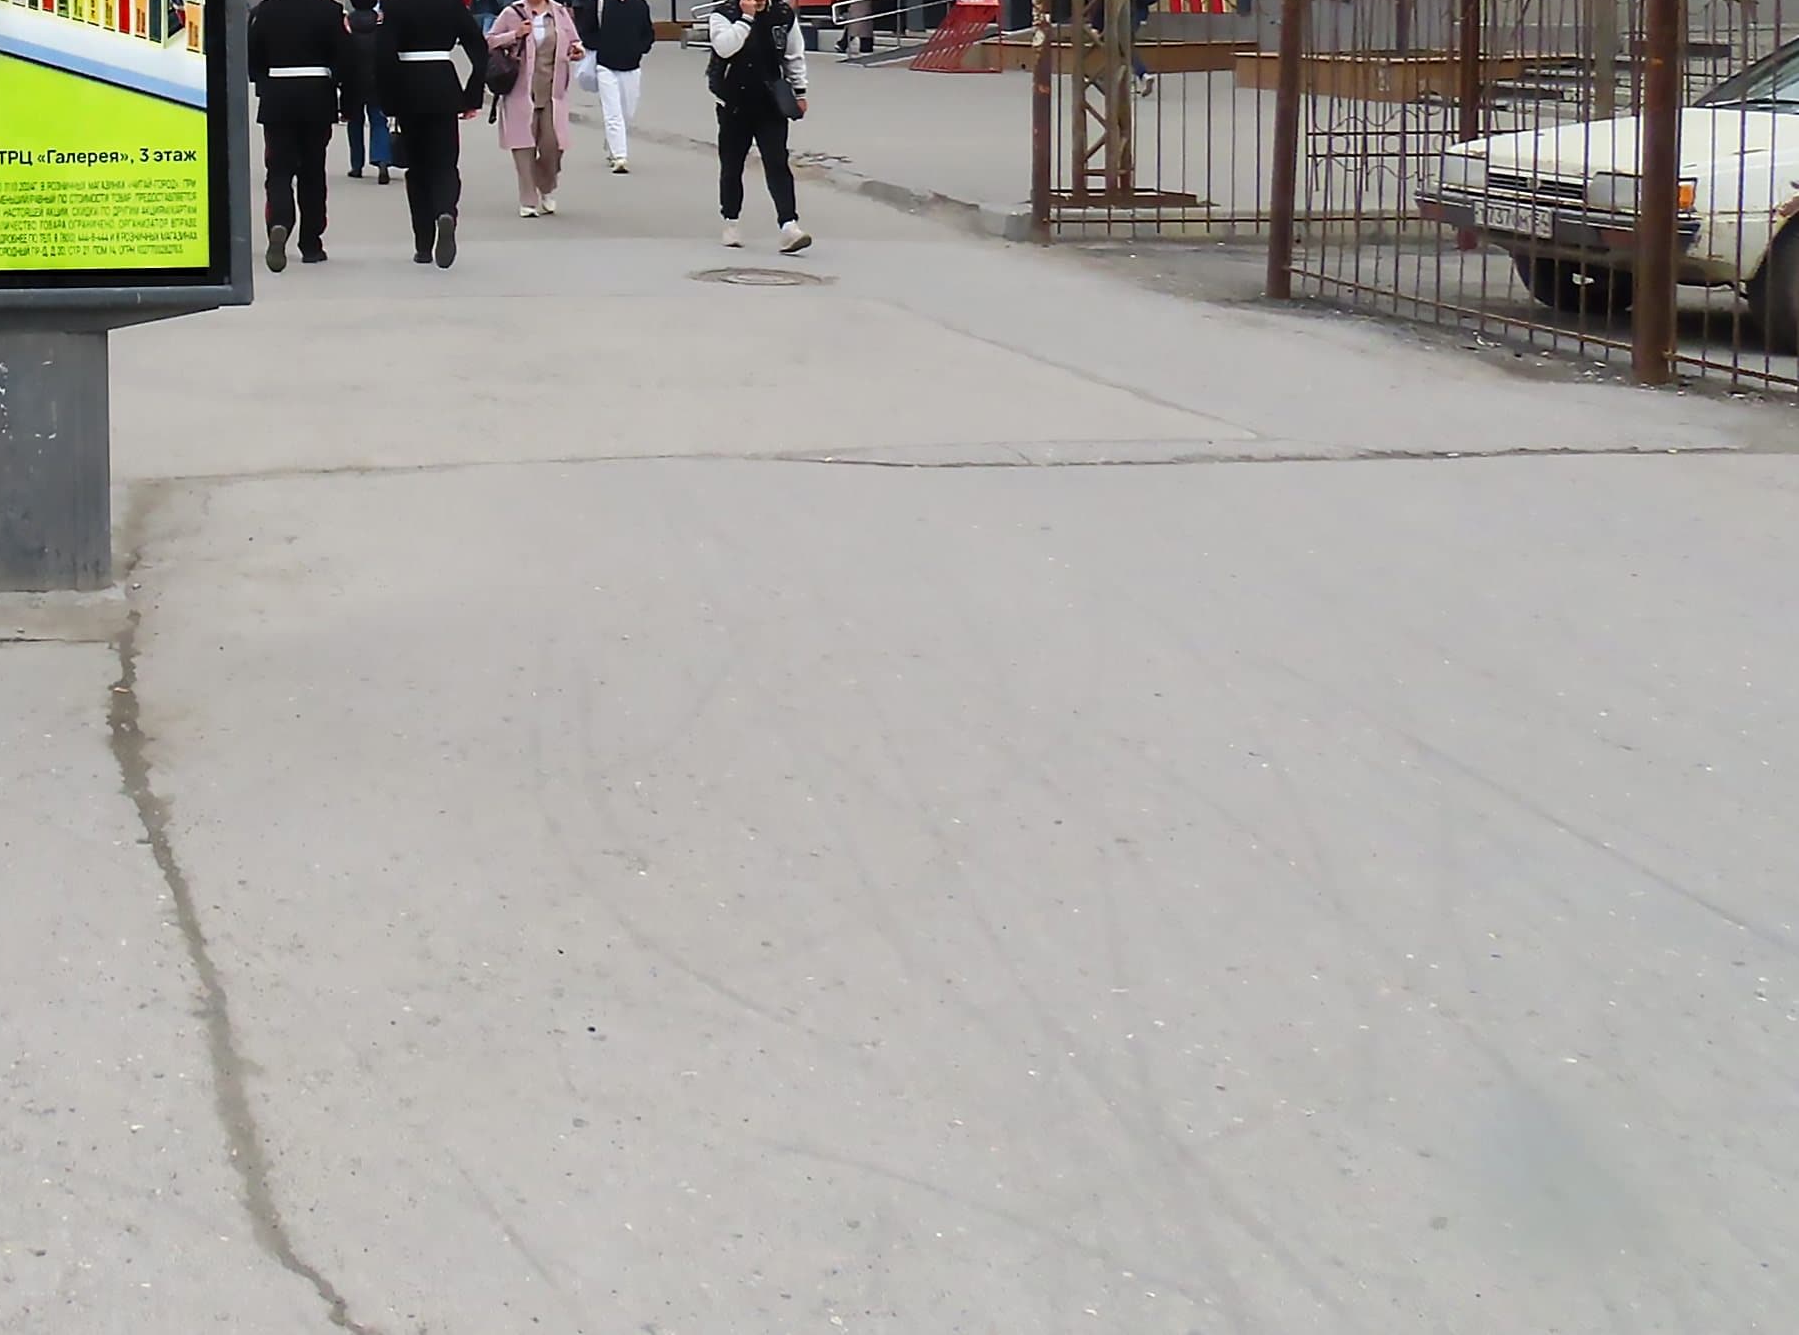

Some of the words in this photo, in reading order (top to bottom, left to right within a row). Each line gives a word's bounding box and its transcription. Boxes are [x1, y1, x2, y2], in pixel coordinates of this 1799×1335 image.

[37, 149, 135, 167] «Галерея»,
[139, 148, 149, 163] 3
[153, 149, 197, 163] этаж
